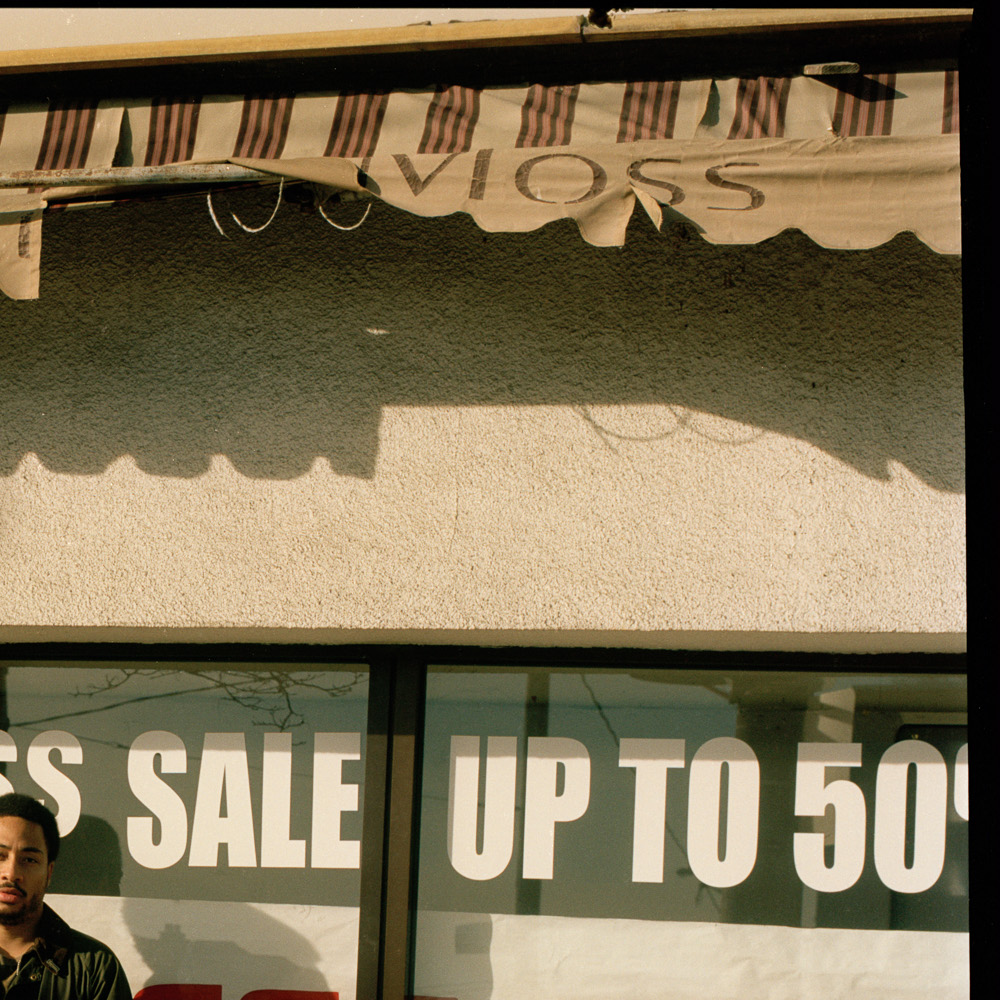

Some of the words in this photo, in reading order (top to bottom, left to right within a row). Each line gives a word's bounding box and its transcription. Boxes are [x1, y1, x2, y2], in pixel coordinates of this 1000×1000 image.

[126, 729, 362, 870] SALE
[447, 735, 591, 881] UP
[618, 736, 761, 888] TO
[793, 739, 969, 893] 50
